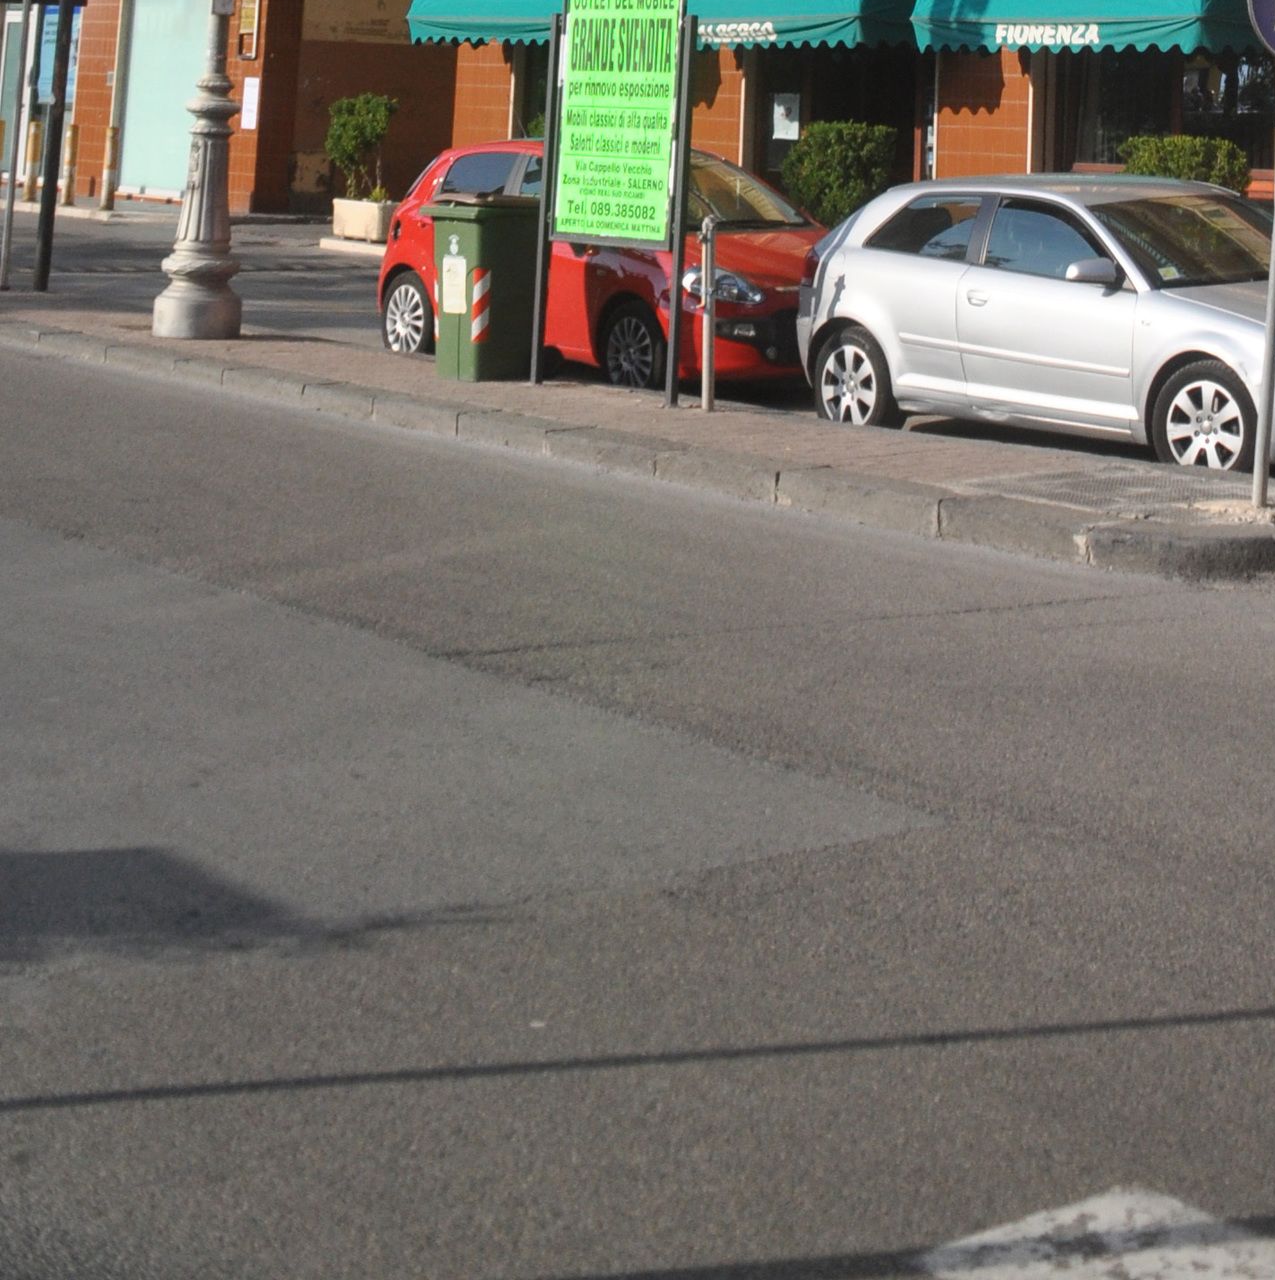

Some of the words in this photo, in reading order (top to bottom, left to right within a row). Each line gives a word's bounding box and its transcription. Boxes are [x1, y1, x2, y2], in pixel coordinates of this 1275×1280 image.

[571, 18, 616, 72] GRANDE
[618, 17, 673, 73] SVENDITA
[995, 23, 1100, 46] FIORENZA
[568, 82, 583, 100] per
[585, 77, 617, 96] rinnovo
[619, 79, 670, 101] esposizione
[566, 109, 587, 127] Mobili
[590, 110, 617, 128] classici
[619, 111, 625, 128] di
[627, 112, 641, 129] alta
[570, 132, 594, 152] Salotti
[595, 133, 623, 153] classici
[631, 136, 661, 155] moderni
[575, 160, 587, 171] Via
[588, 161, 620, 174] Cappello
[623, 163, 652, 176] Vecchio
[563, 173, 580, 185] Zona
[582, 175, 621, 188] Industriale
[627, 179, 664, 191] SALERNO
[567, 199, 587, 215] Tel.
[590, 201, 656, 220] 089.385082
[561, 218, 585, 228] APERTO
[586, 219, 594, 229] LA
[595, 220, 630, 232] DOMENICA
[631, 224, 661, 234] MATTINA
